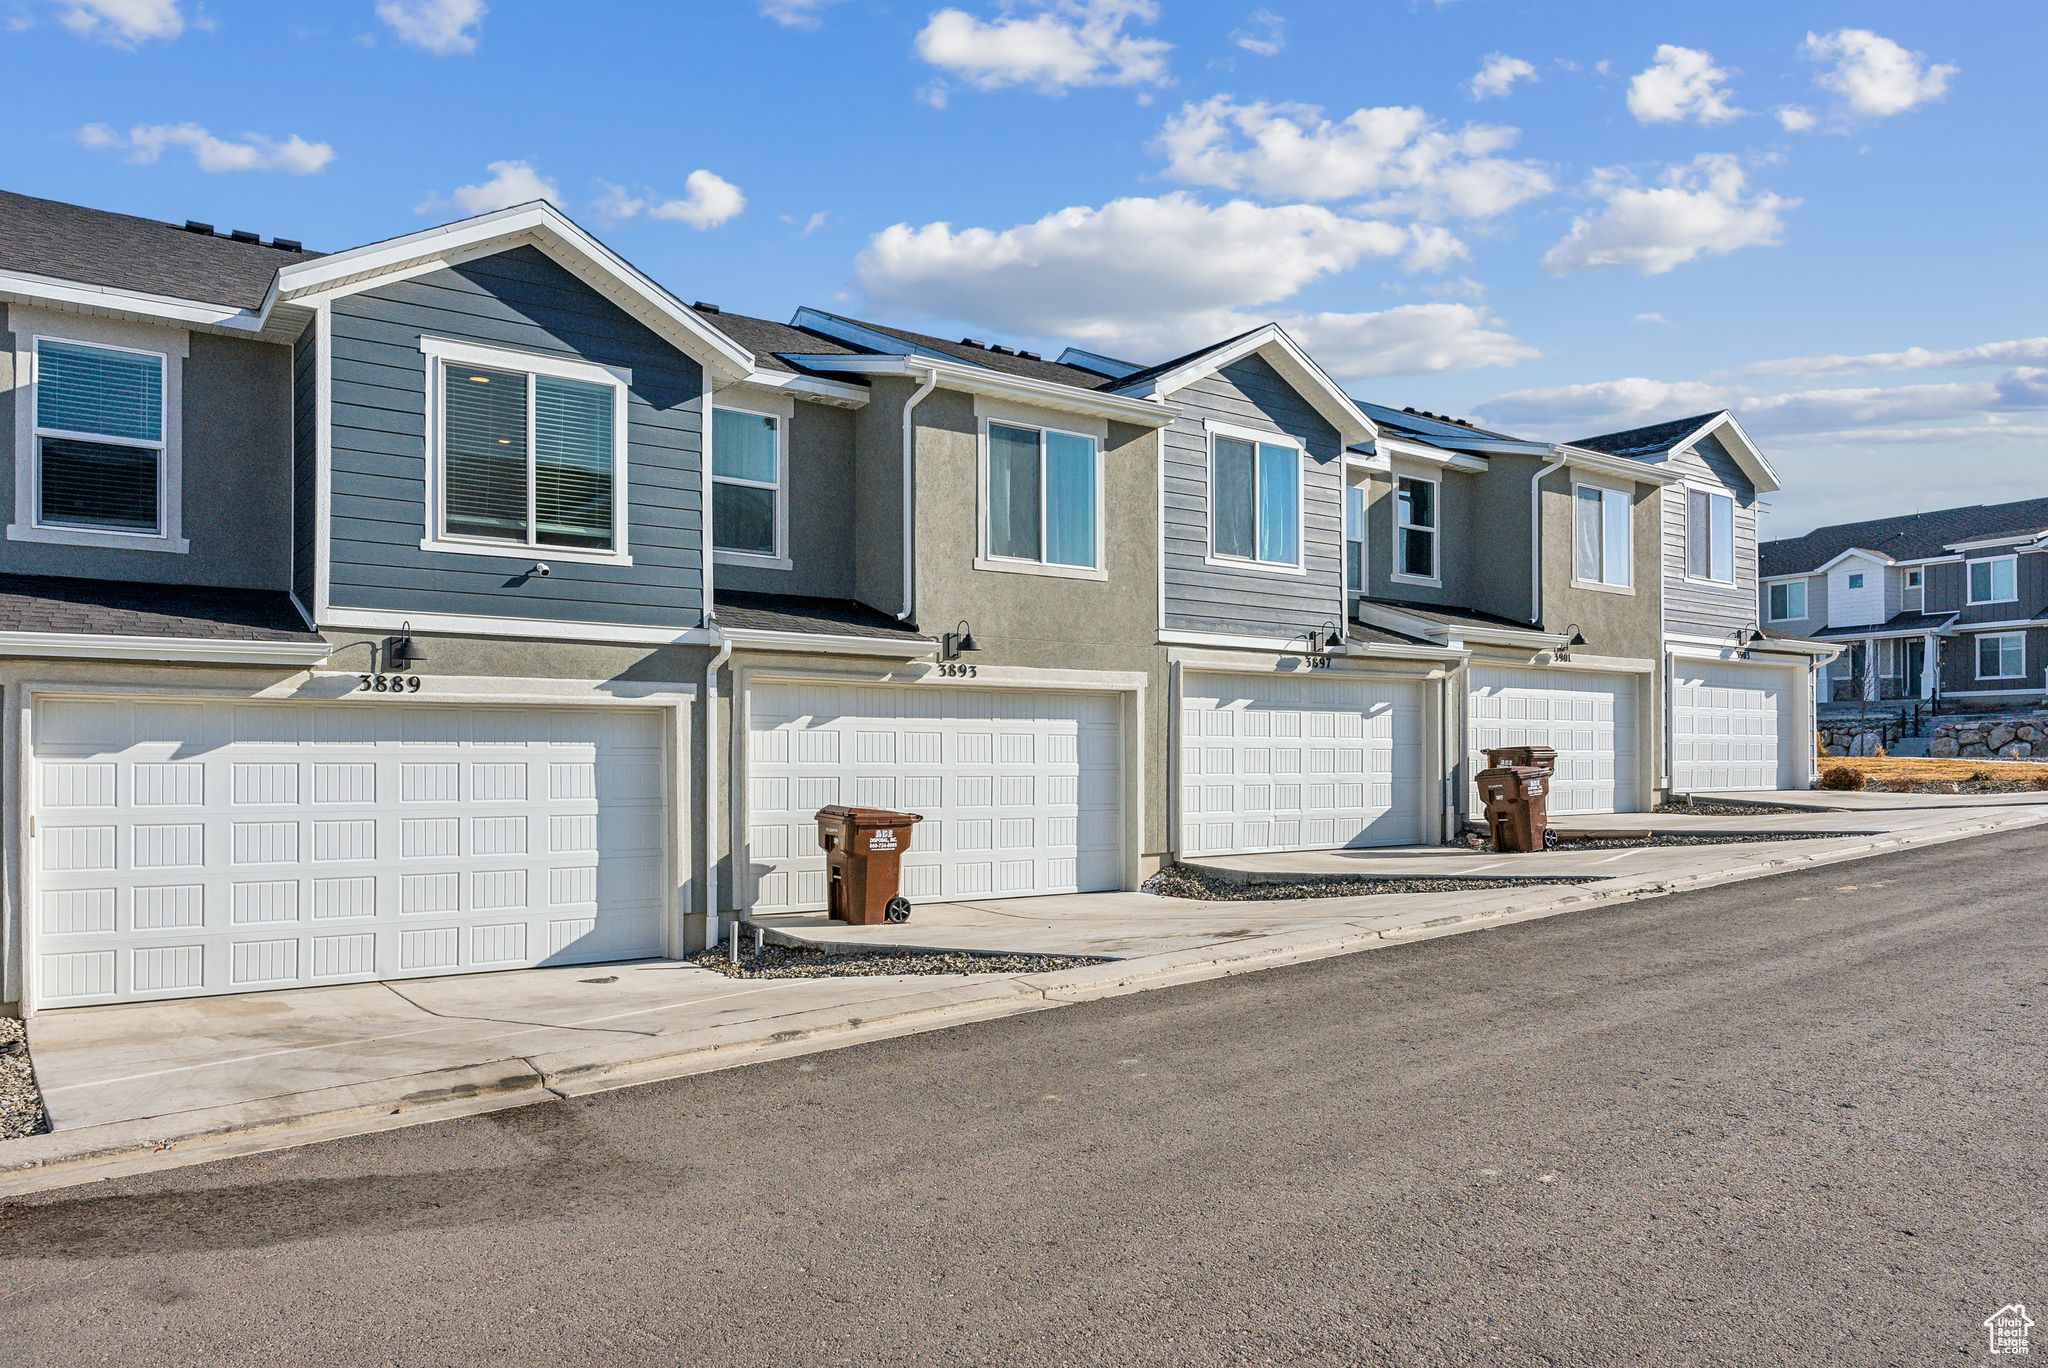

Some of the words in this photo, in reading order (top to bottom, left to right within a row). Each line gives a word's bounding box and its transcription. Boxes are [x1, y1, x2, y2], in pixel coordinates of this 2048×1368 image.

[1305, 656, 1331, 669] 3897
[1554, 653, 1571, 662] 3901
[938, 664, 977, 678] 3893
[358, 674, 421, 693] 3889
[875, 829, 893, 837] ACE
